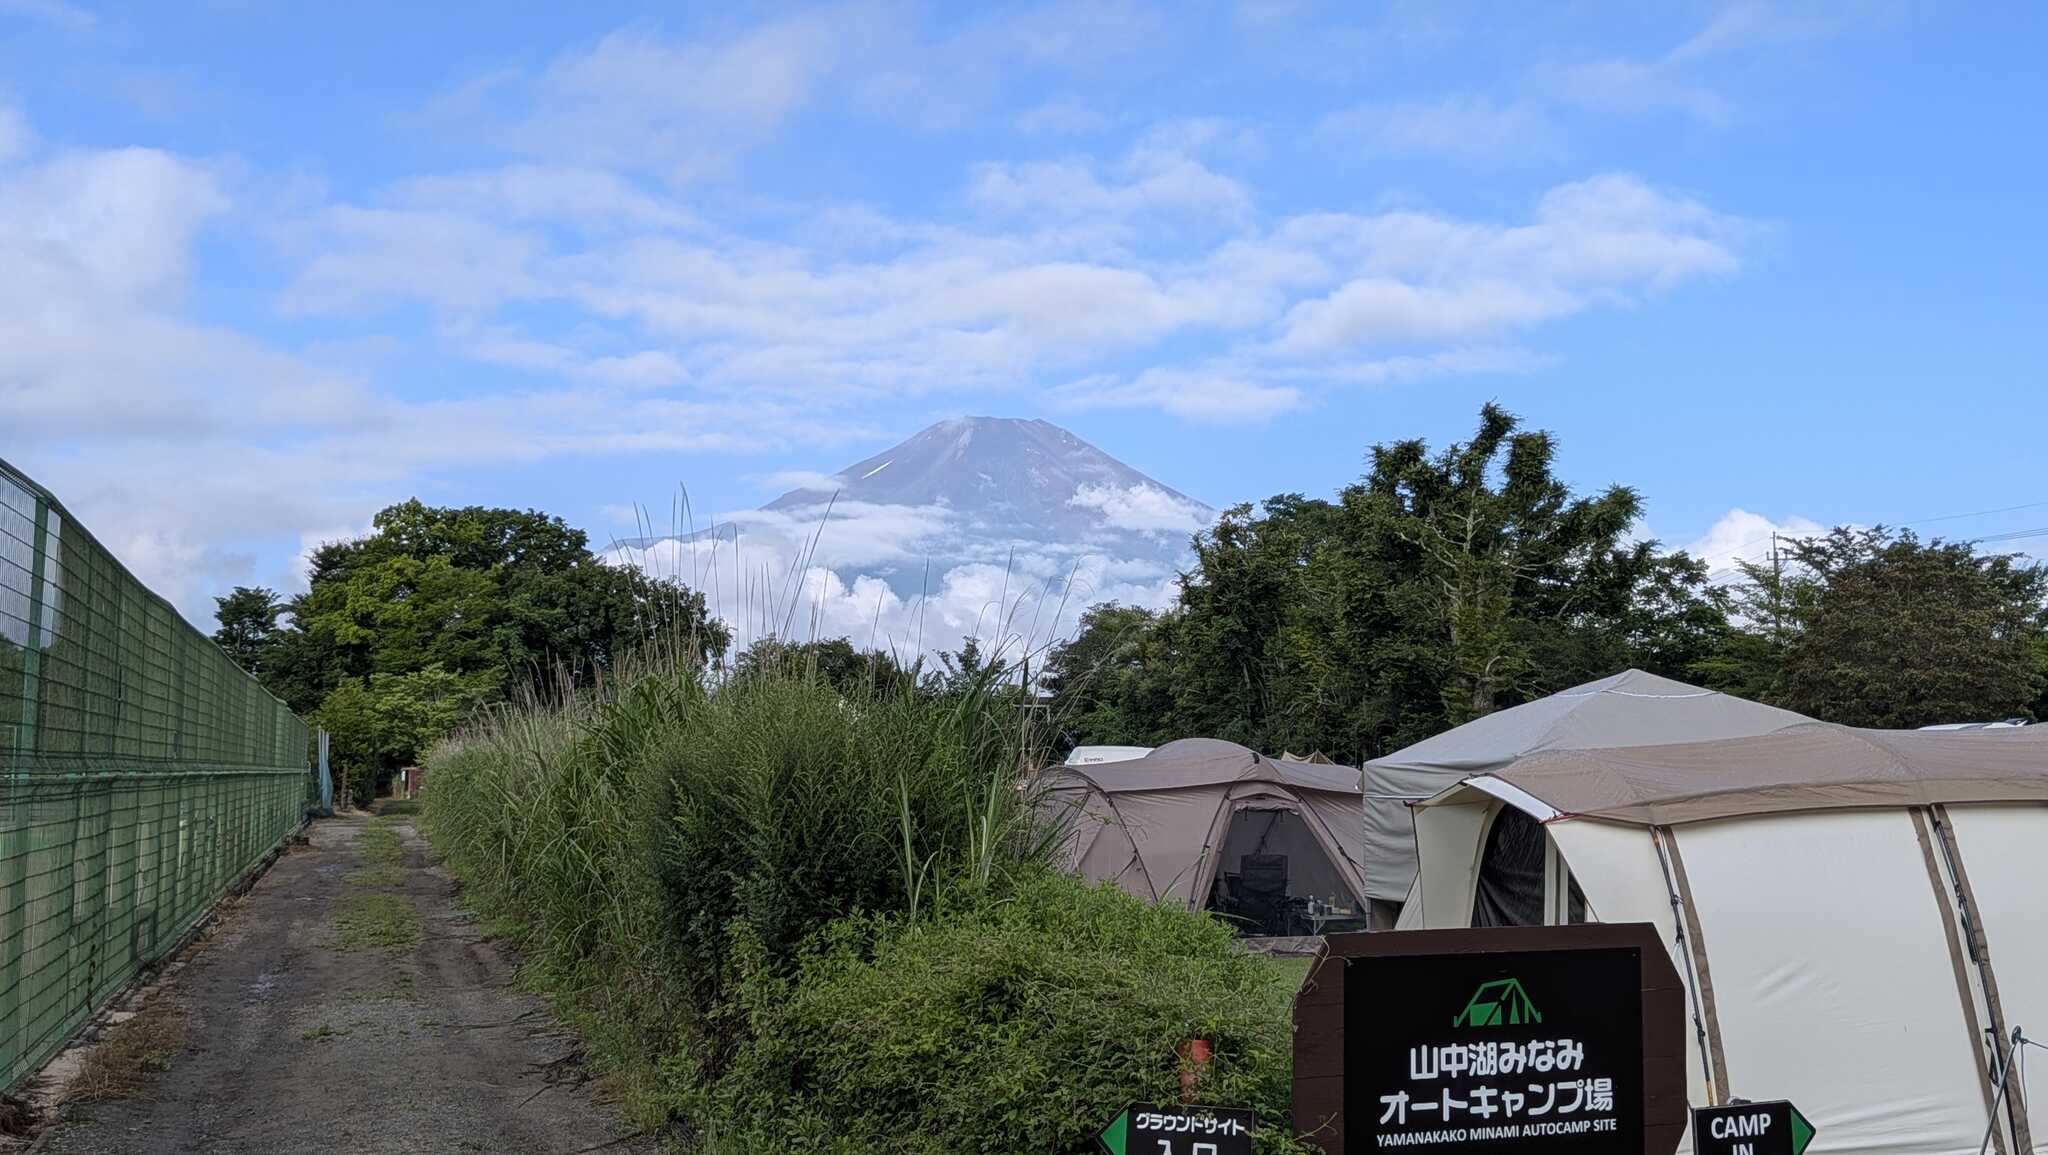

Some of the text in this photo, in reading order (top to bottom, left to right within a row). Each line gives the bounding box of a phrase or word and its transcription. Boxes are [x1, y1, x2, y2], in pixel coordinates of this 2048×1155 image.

[1409, 1038, 1585, 1081] 山中湖みなみ
[1378, 1077, 1615, 1126] オートキャンプ場
[1376, 1117, 1618, 1148] YAMANAKAKO MINAMI AUTOCAMP SITE
[1710, 1112, 1772, 1140] CAMP
